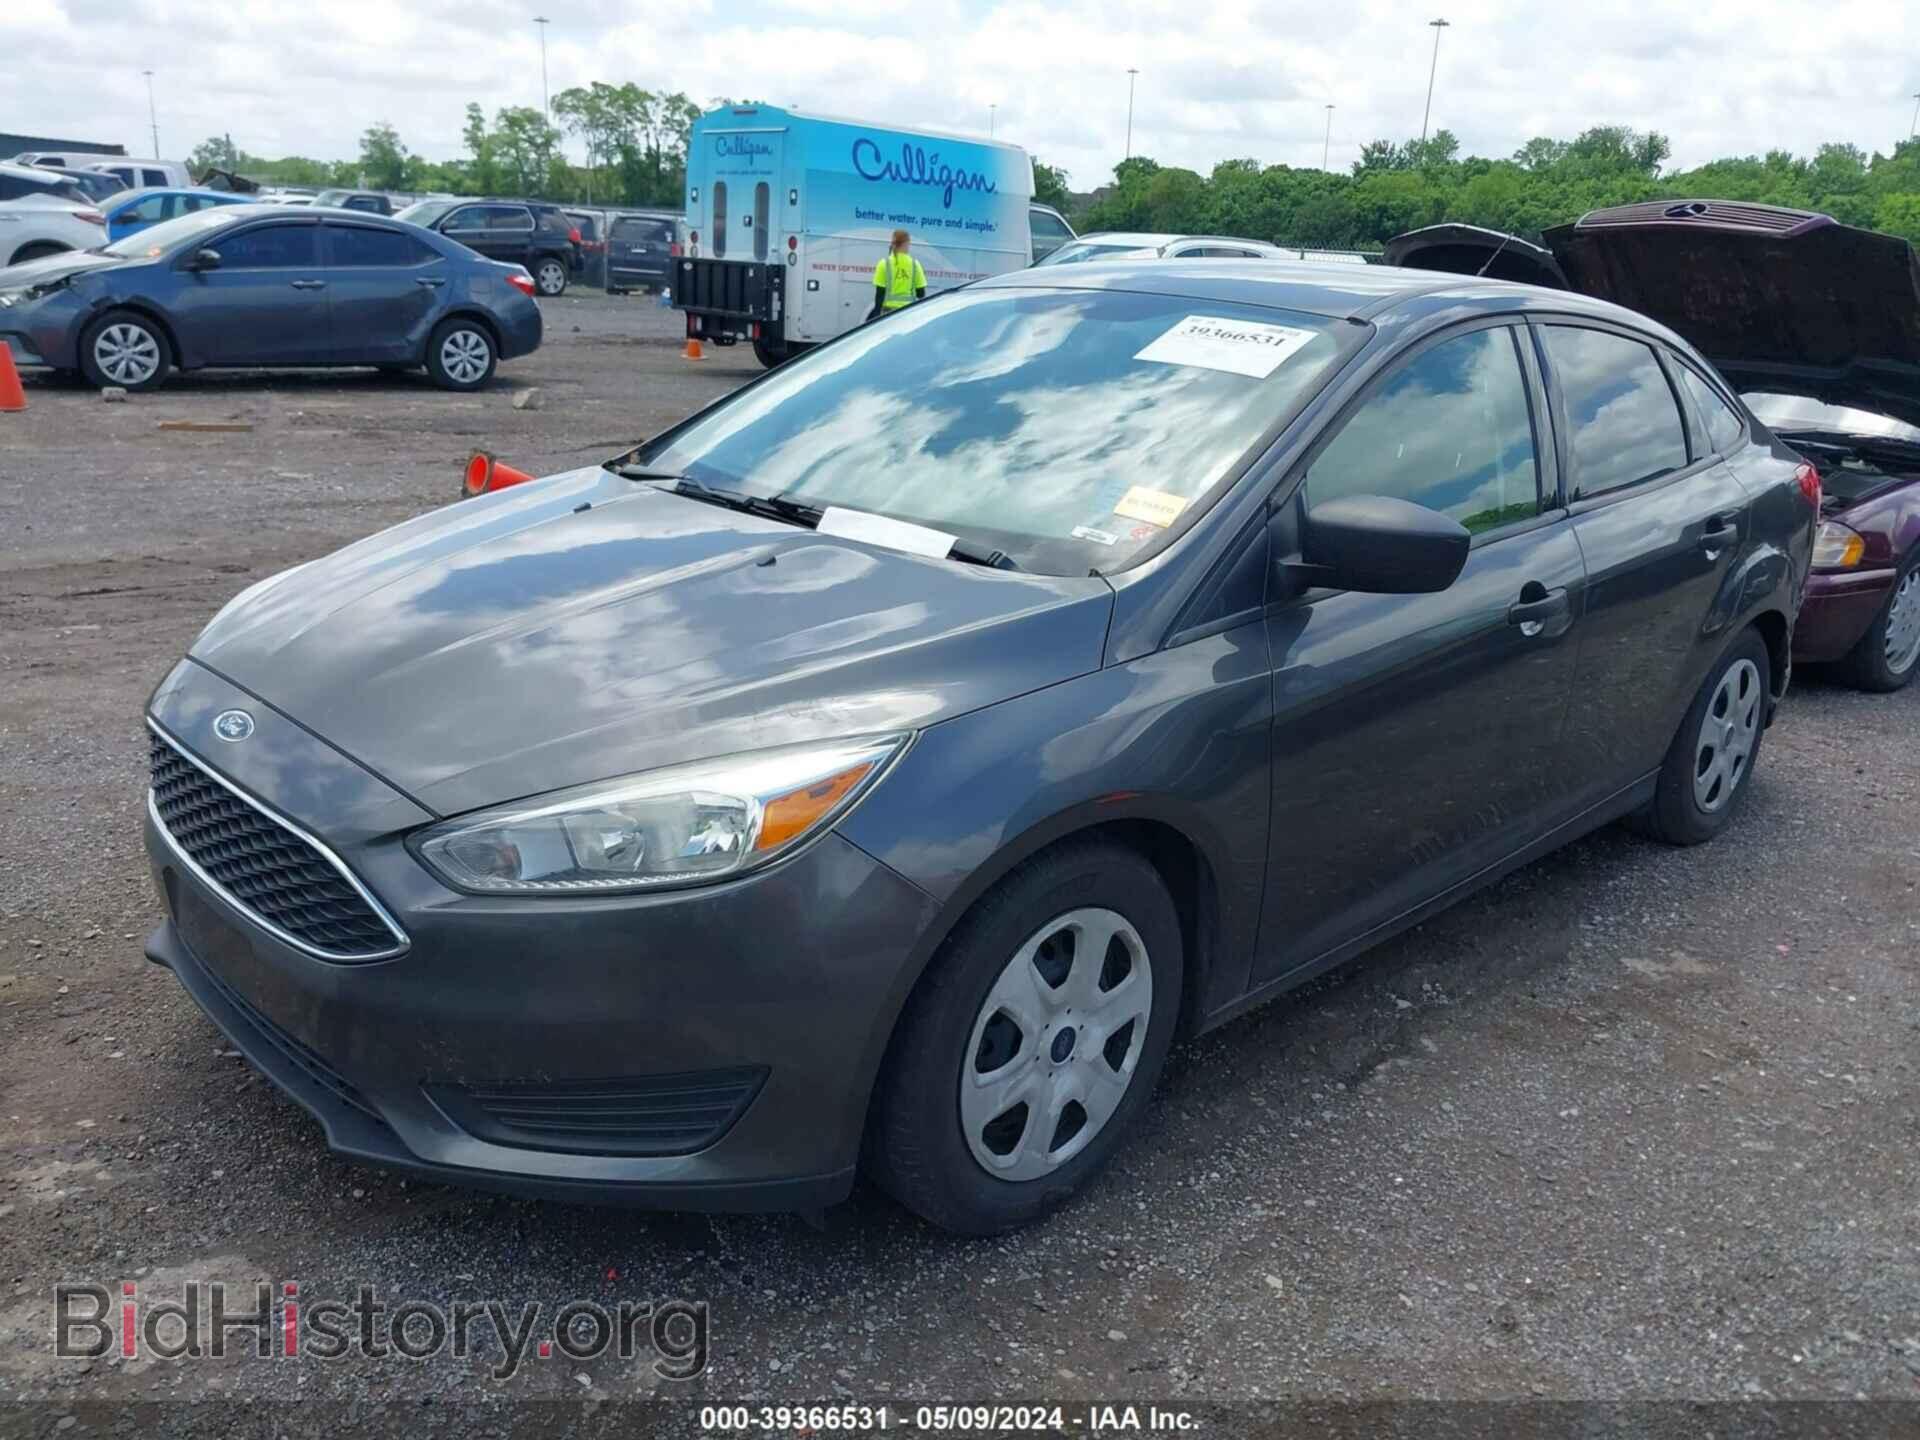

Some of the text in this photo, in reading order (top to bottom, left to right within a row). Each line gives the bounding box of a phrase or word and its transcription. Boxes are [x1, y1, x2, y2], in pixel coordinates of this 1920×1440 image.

[715, 135, 774, 166] Culligan
[852, 138, 996, 209] Culligan
[855, 206, 884, 221] better
[920, 216, 943, 229] pure
[945, 216, 962, 228] and
